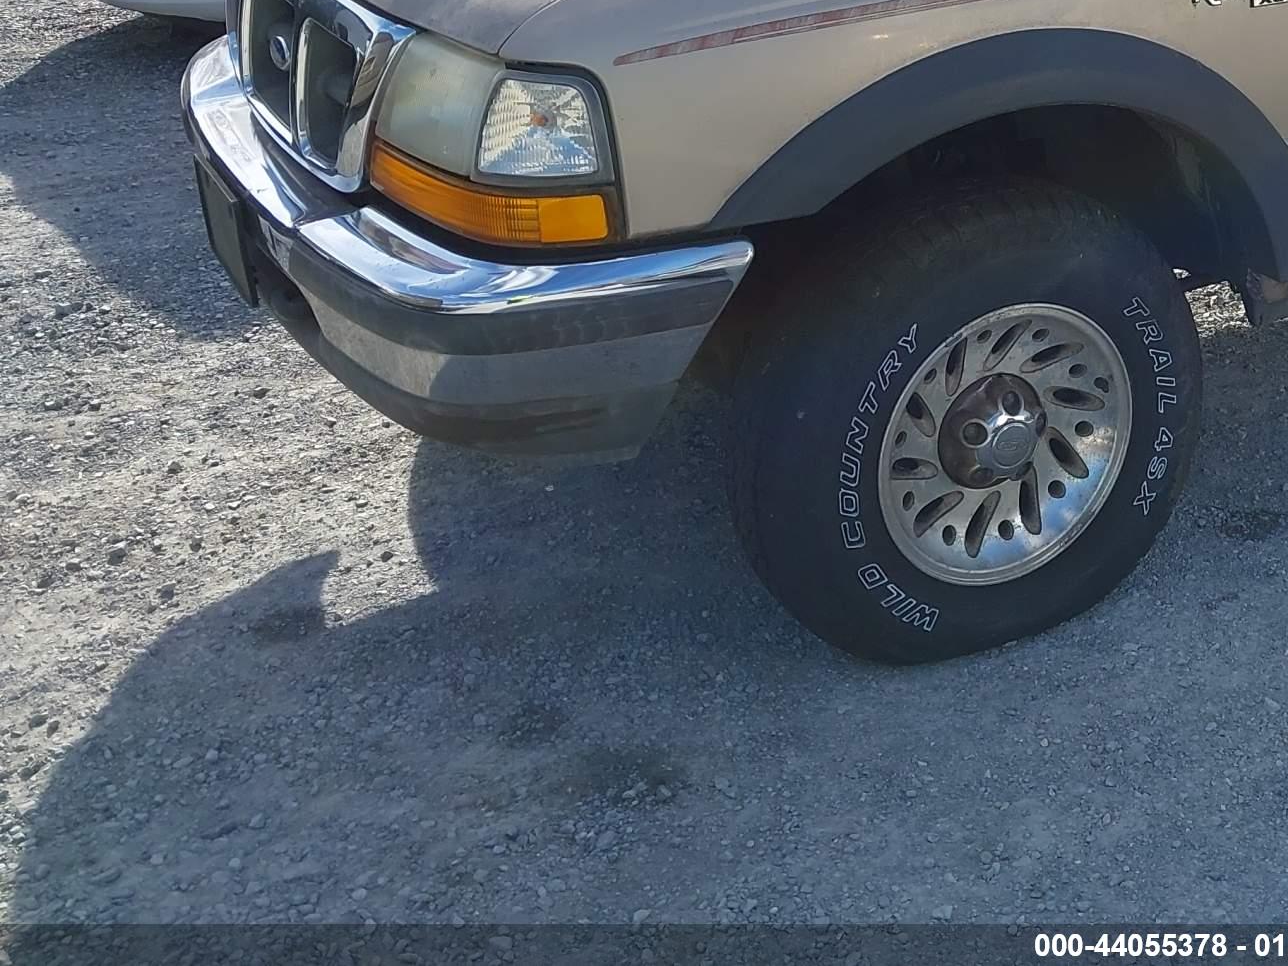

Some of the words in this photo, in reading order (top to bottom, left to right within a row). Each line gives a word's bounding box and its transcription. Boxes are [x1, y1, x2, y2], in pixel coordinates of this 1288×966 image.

[1122, 297, 1178, 414] TRAIL
[838, 322, 919, 549] COUNTRY
[1133, 426, 1174, 516] 4SX
[857, 563, 939, 632] WILD
